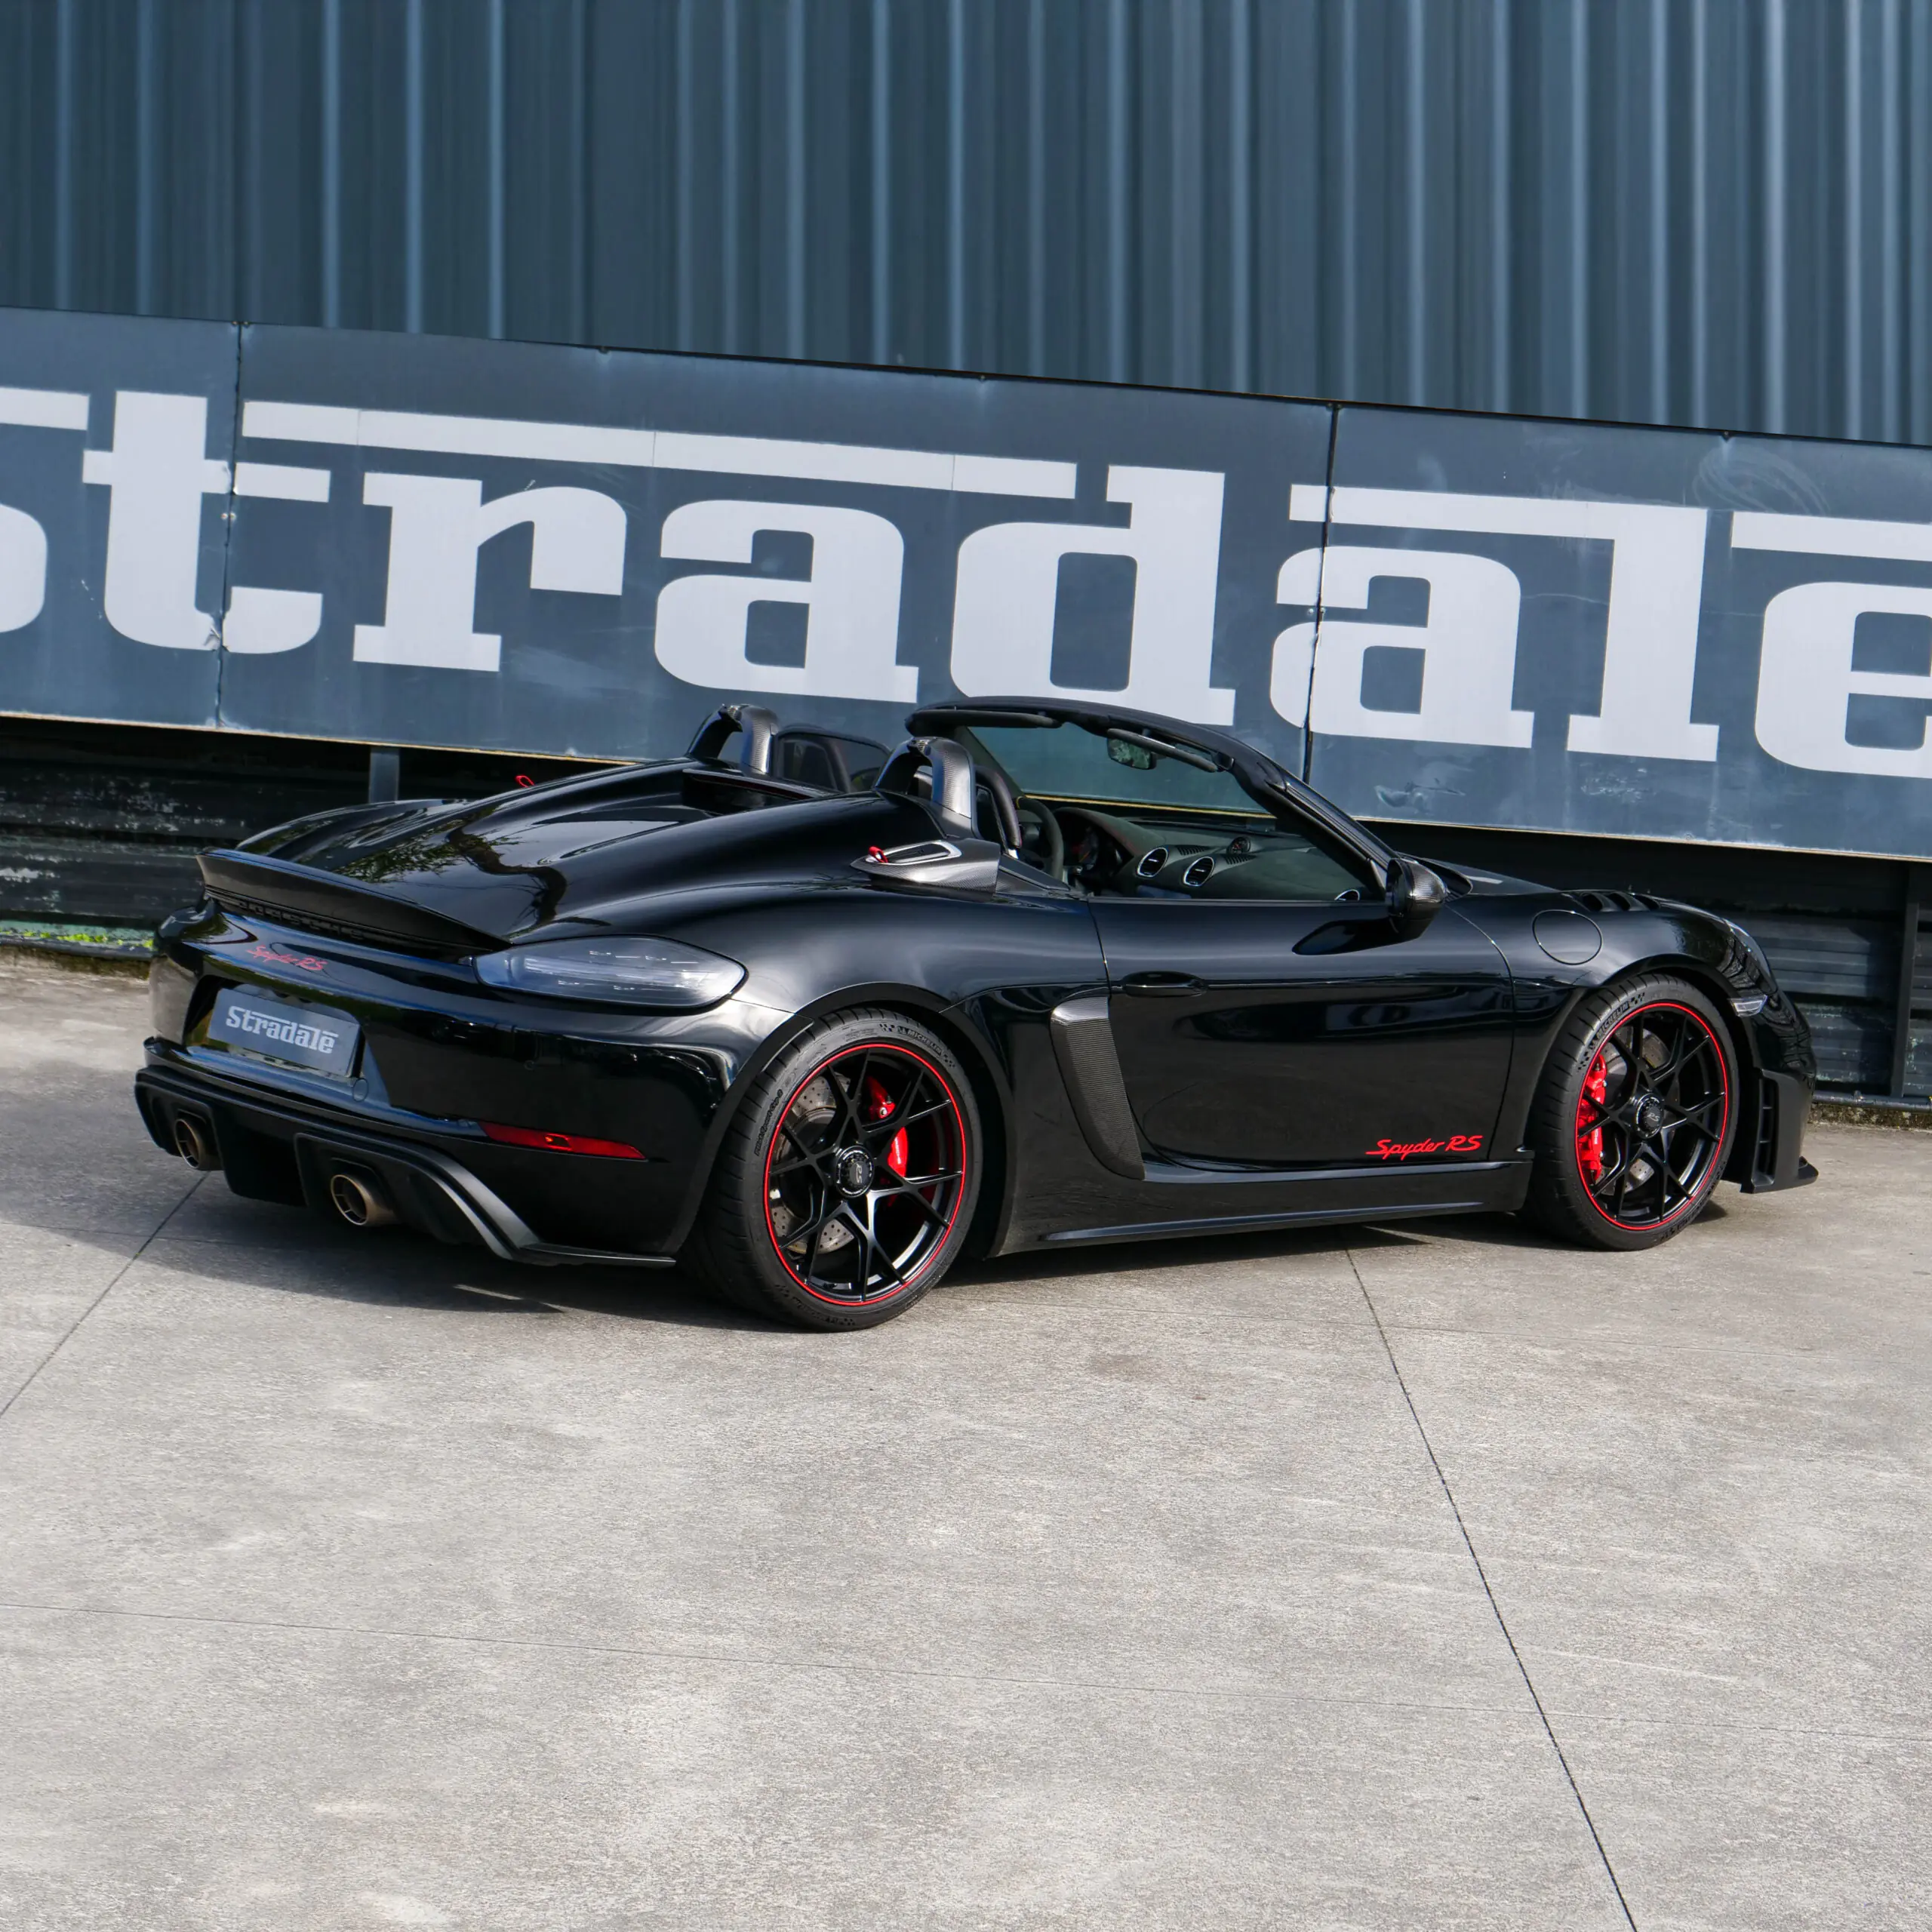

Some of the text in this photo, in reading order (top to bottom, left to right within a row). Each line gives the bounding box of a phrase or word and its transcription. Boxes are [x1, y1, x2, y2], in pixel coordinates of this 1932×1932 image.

[0, 388, 1932, 778] tradale
[295, 957, 328, 971] RS
[226, 1005, 339, 1054] Stradale
[1364, 1135, 1484, 1161] Spyder RS
